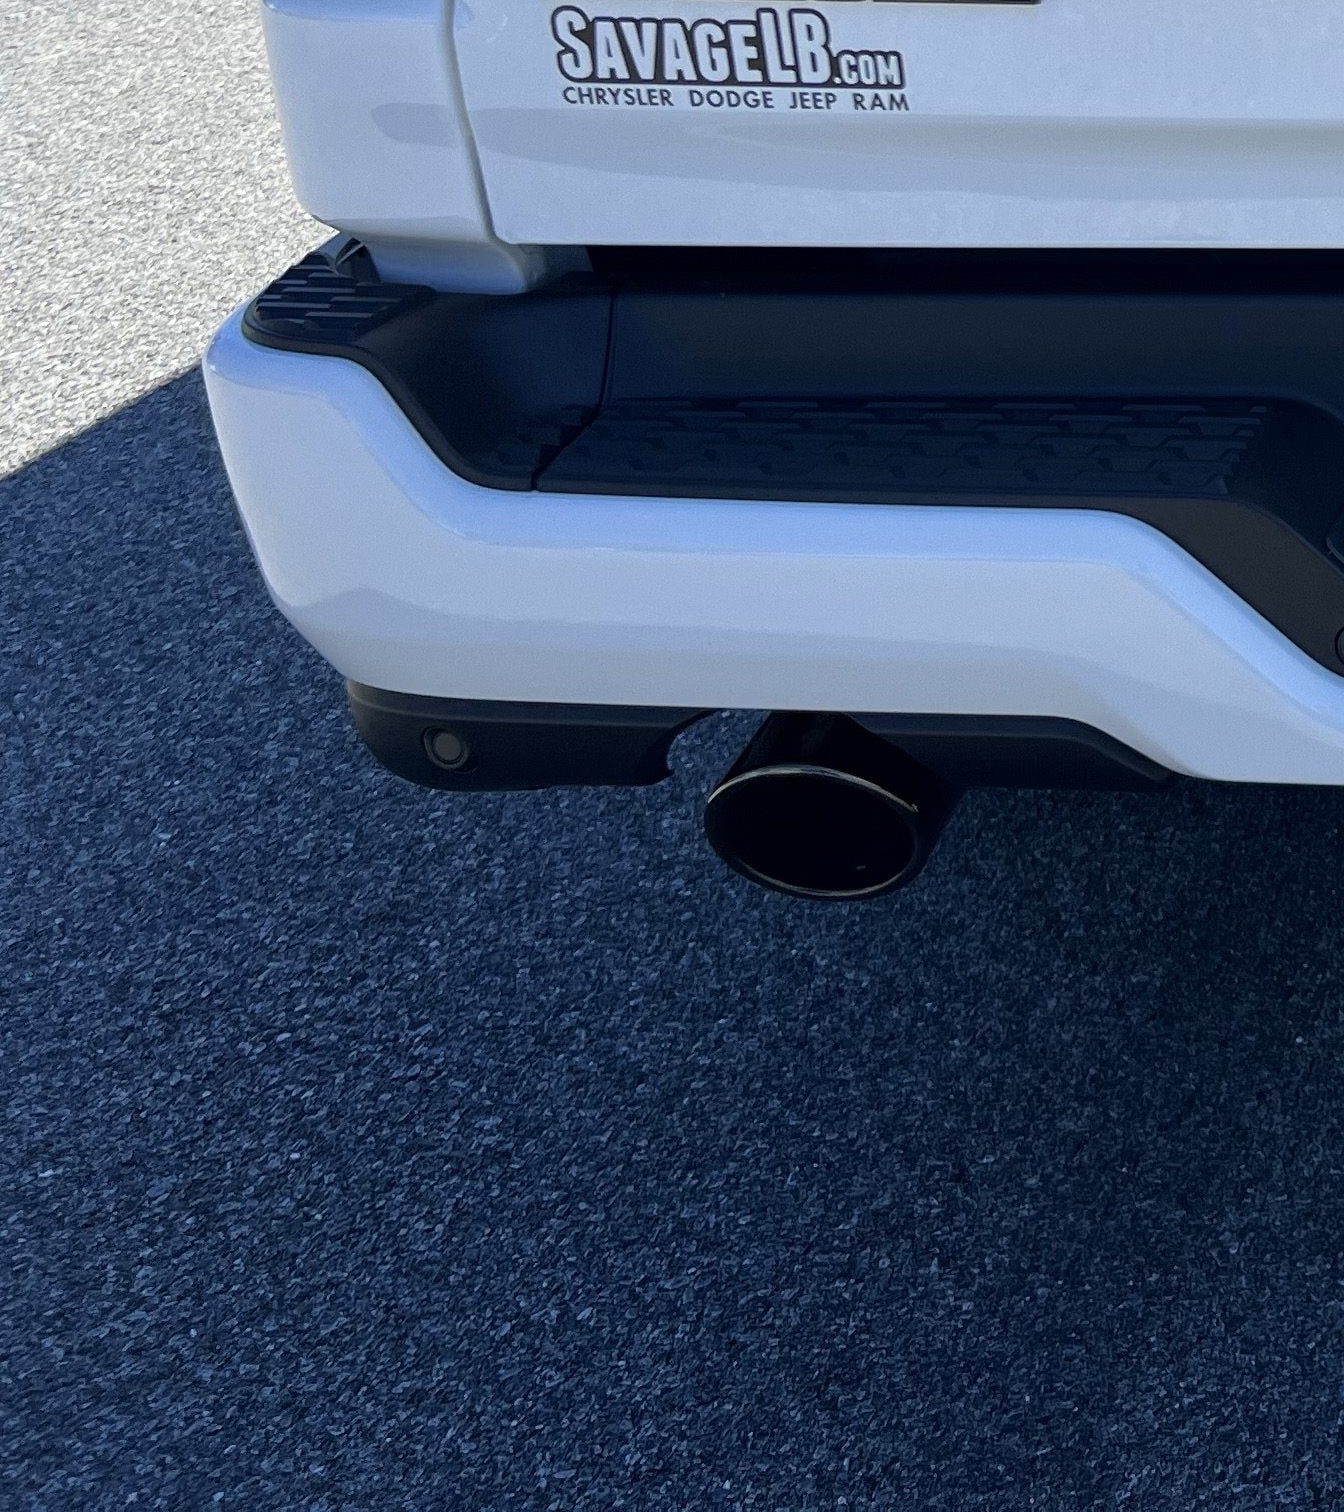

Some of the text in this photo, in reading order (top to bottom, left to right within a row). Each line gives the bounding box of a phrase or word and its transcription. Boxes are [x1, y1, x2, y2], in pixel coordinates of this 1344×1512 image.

[562, 86, 910, 112] CHRYSLER DODGE JEEP RAM
